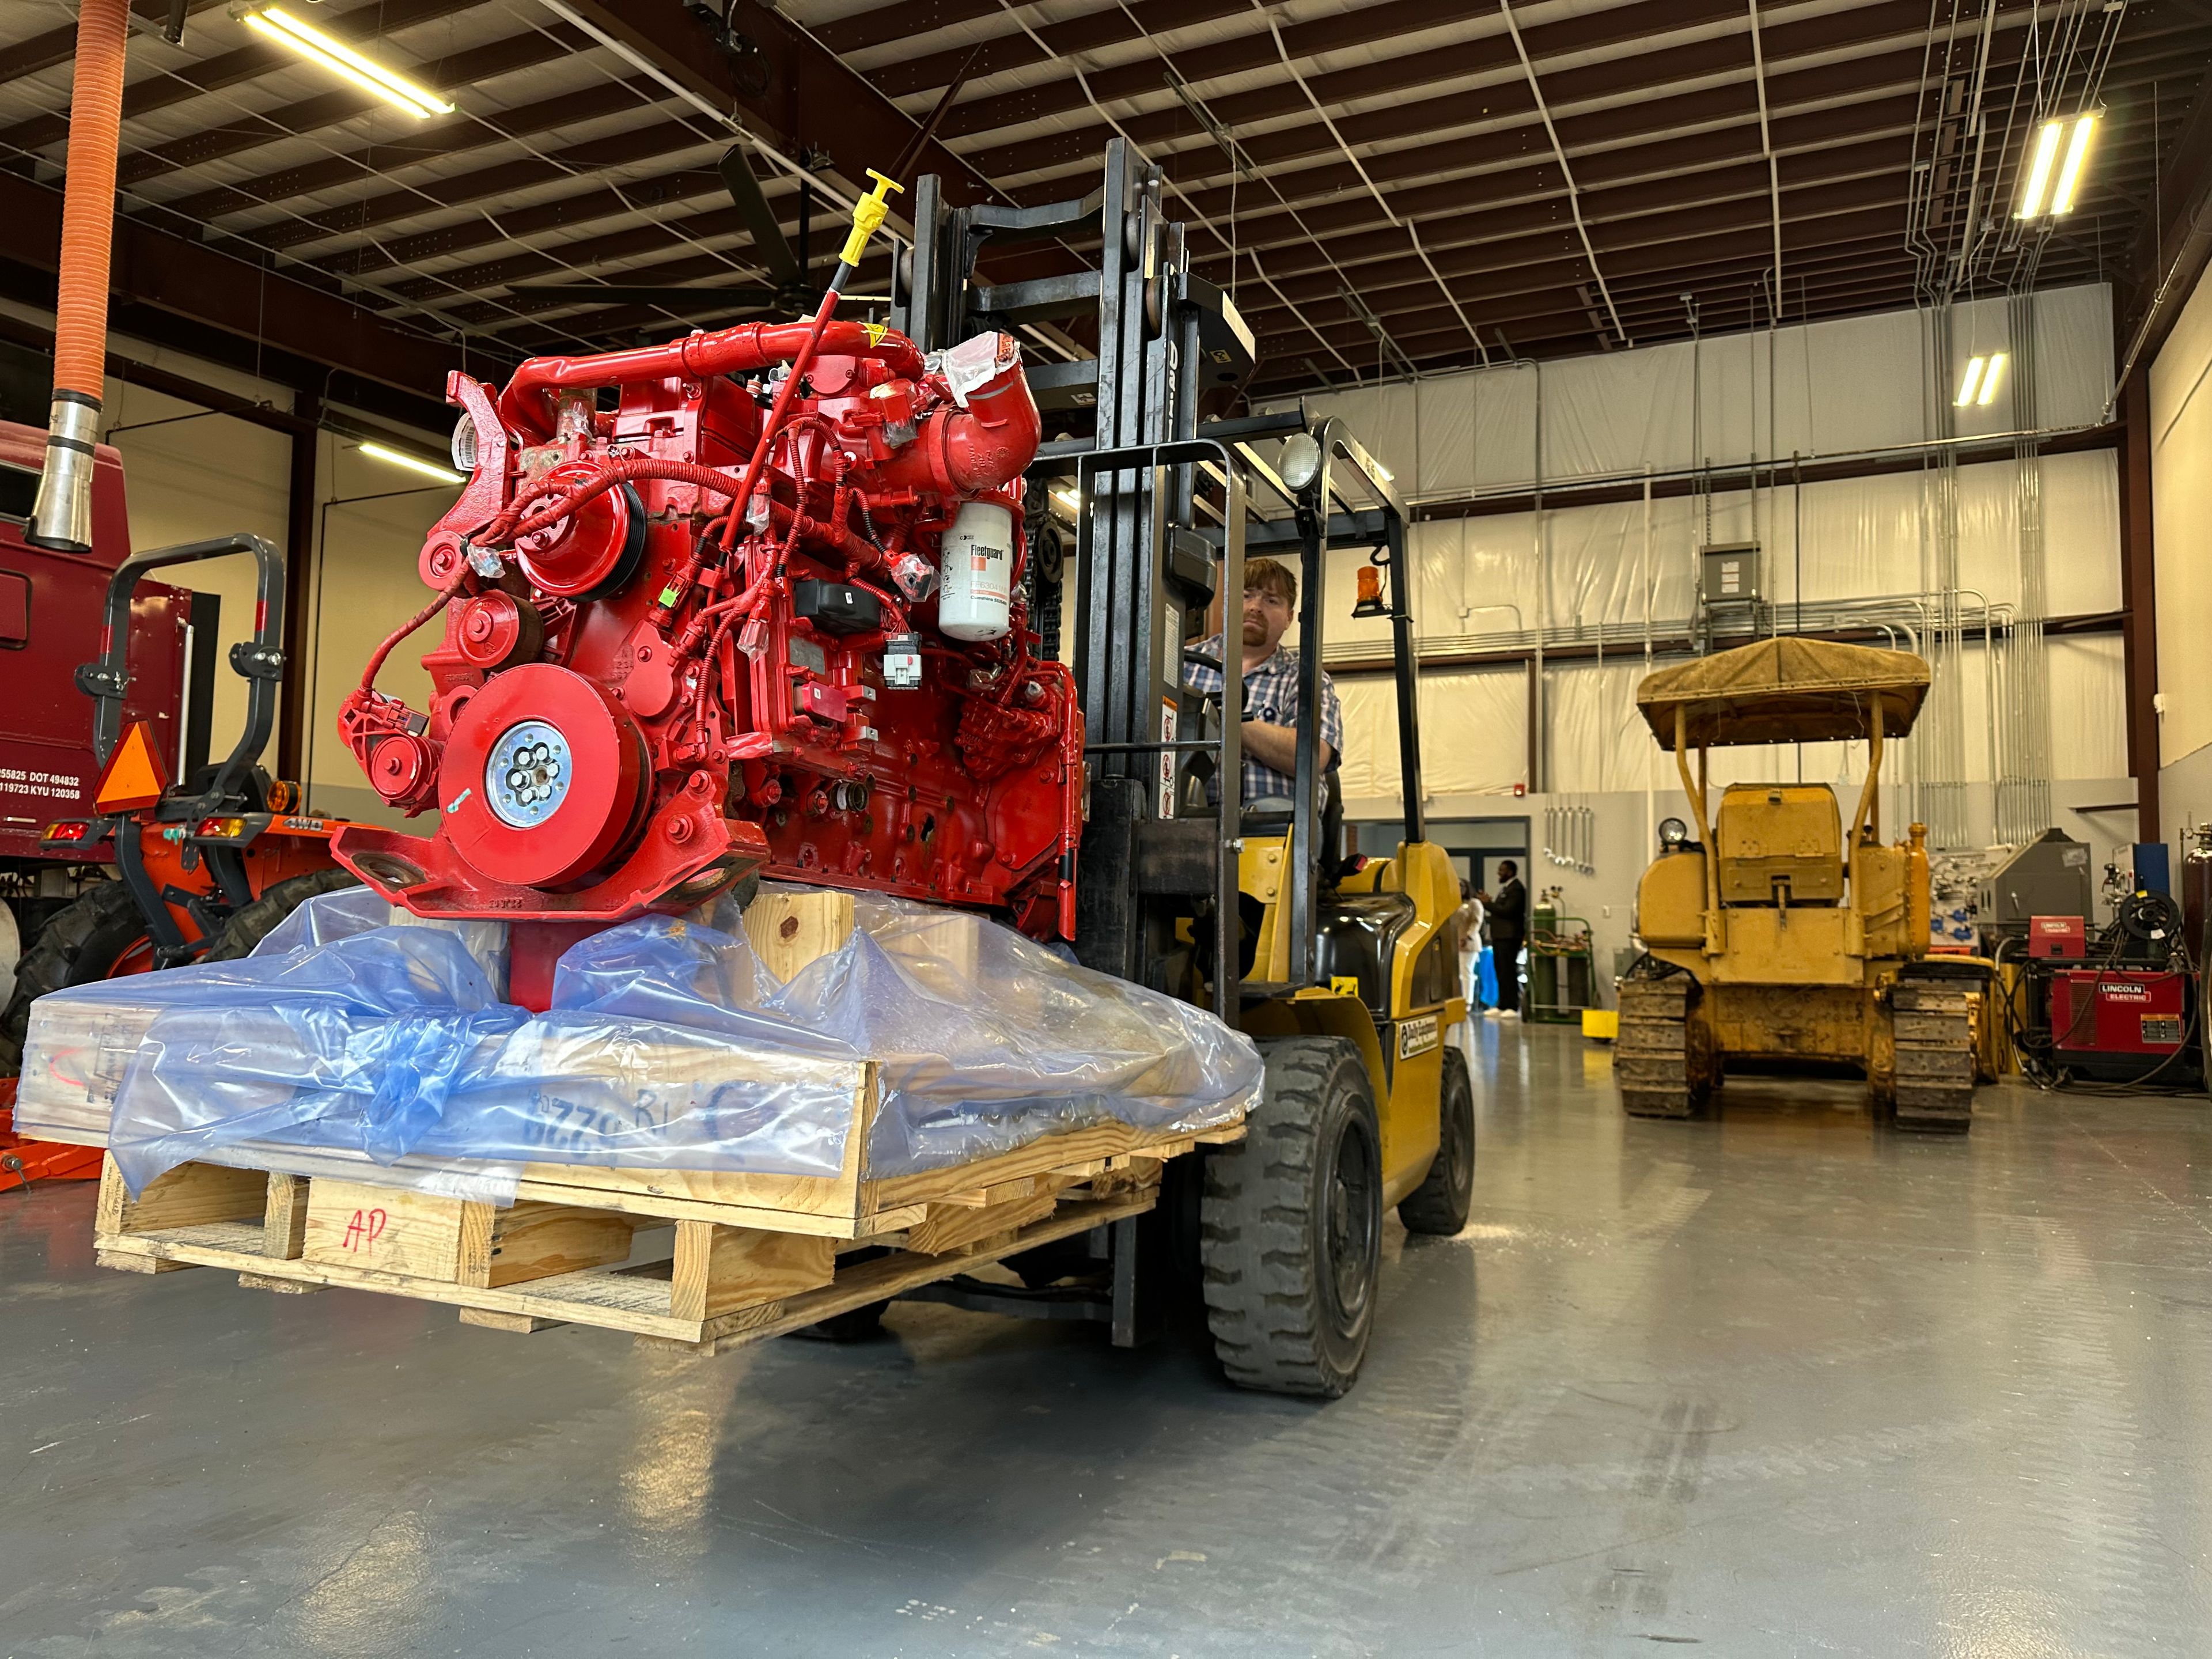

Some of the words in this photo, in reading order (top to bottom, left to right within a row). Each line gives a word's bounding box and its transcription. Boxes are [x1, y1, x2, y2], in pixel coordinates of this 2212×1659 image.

[971, 544, 1003, 560] Fleetguard
[0, 768, 26, 781] 55825
[29, 772, 49, 783] DOT
[50, 775, 79, 786] 494832
[31, 785, 49, 796] KYU
[51, 787, 80, 800] 120358
[283, 818, 323, 831] 4WD
[2102, 985, 2142, 993] LINCOLN
[2110, 993, 2147, 1001] ELECTRIC
